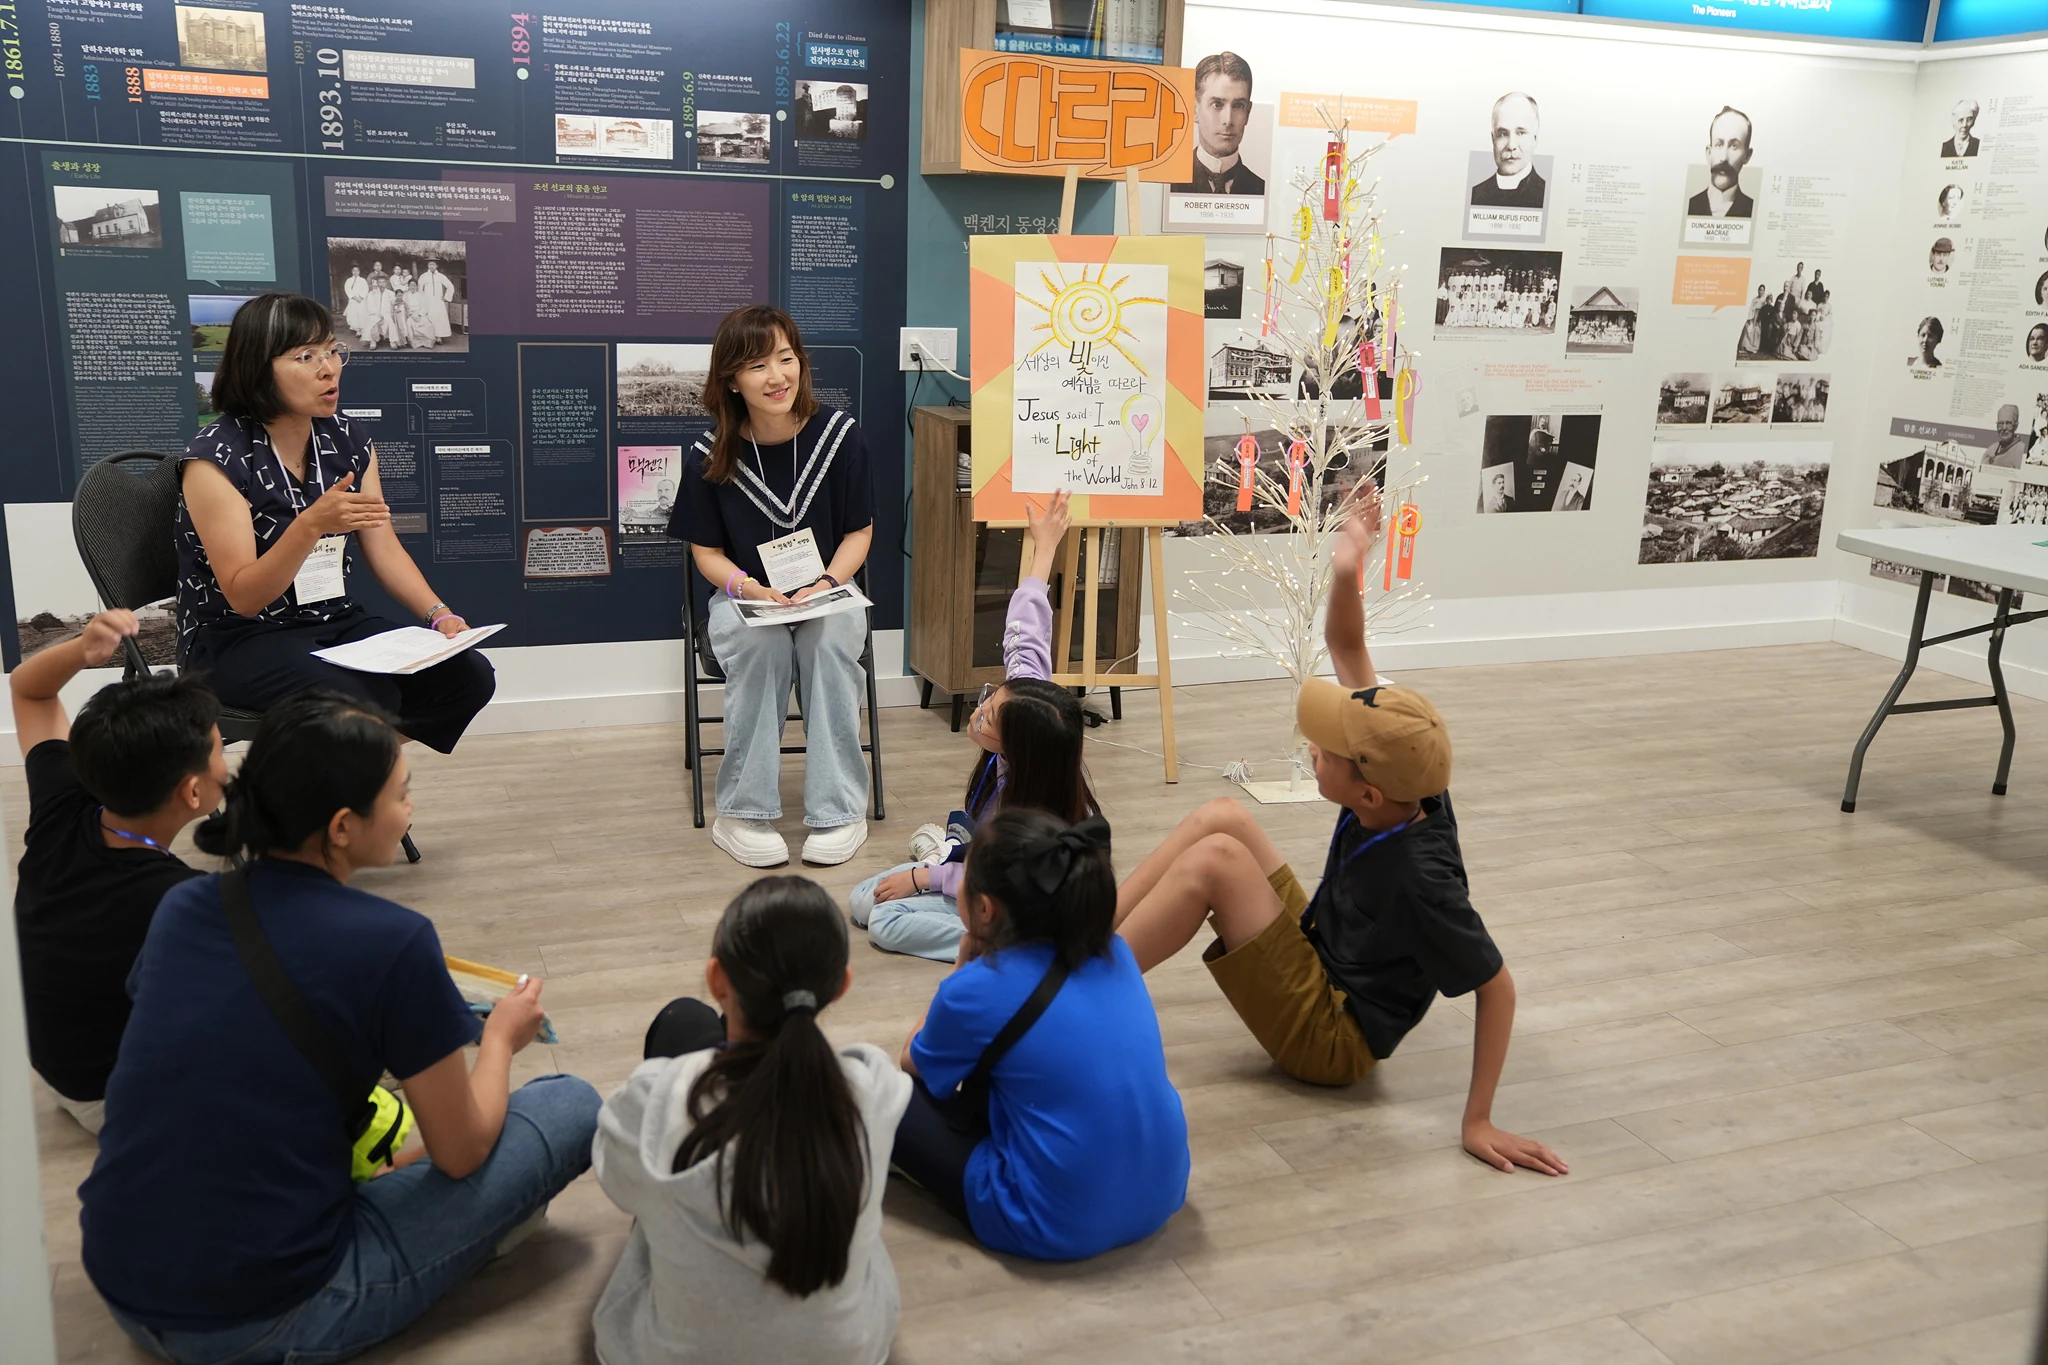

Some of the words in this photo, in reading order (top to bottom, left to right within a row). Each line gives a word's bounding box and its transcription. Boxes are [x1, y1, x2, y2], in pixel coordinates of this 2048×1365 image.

[47, 6, 70, 14] Taught
[90, 10, 123, 18] hometown
[123, 12, 143, 20] school
[1692, 4, 1705, 15] The
[1706, 5, 1736, 19] Pioneers
[0, 0, 24, 80] 1861.7.1
[511, 12, 530, 65] 1894
[808, 31, 823, 39] Died
[845, 34, 866, 42] illness
[49, 22, 66, 78] 1874-1880
[81, 44, 127, 55] 달하우지대학
[128, 48, 144, 57] 입학
[293, 40, 305, 65] 1891
[810, 46, 845, 56] 일사병으로
[845, 48, 859, 57] 인한
[83, 55, 115, 63] Admission
[123, 57, 153, 65] Dalhousie
[775, 21, 790, 107] 1895.6.22
[810, 56, 850, 66] 건강이상으로
[851, 58, 865, 68] 소천
[84, 64, 101, 100] 1883
[125, 66, 143, 103] 1888
[316, 48, 345, 151] 1893.10
[683, 71, 695, 128] 1895.6.9
[964, 61, 1185, 168] 따르라
[353, 119, 363, 142] 11.27
[52, 160, 80, 171] 출생과
[82, 163, 101, 172] 성장
[532, 183, 549, 192] 조선
[551, 183, 573, 193] 선교의
[575, 184, 591, 194] 꿈을
[592, 185, 608, 194] 안고
[792, 193, 799, 202] 한
[800, 193, 815, 203] 알의
[816, 194, 837, 203] 밀알이
[838, 195, 852, 204] 되어
[1184, 201, 1213, 209] ROBERT
[1214, 202, 1250, 210] GRIERSON
[963, 213, 1010, 234] 맥켄지
[1015, 216, 1060, 234] 동영상
[1016, 353, 1060, 373] 세상의
[1061, 377, 1102, 394] 예수님을
[1108, 376, 1147, 393] 따르라
[1017, 398, 1060, 422] Jesus
[1093, 402, 1105, 427] I
[1107, 418, 1121, 426] am
[1919, 426, 1938, 436] 선교부
[1030, 433, 1050, 445] the
[1055, 424, 1101, 461] Light
[1086, 454, 1098, 467] of
[628, 457, 668, 484] 맥켄지
[1064, 471, 1082, 483] the
[1083, 466, 1121, 485] World
[1121, 478, 1139, 490] John
[1140, 478, 1158, 490] 8:12
